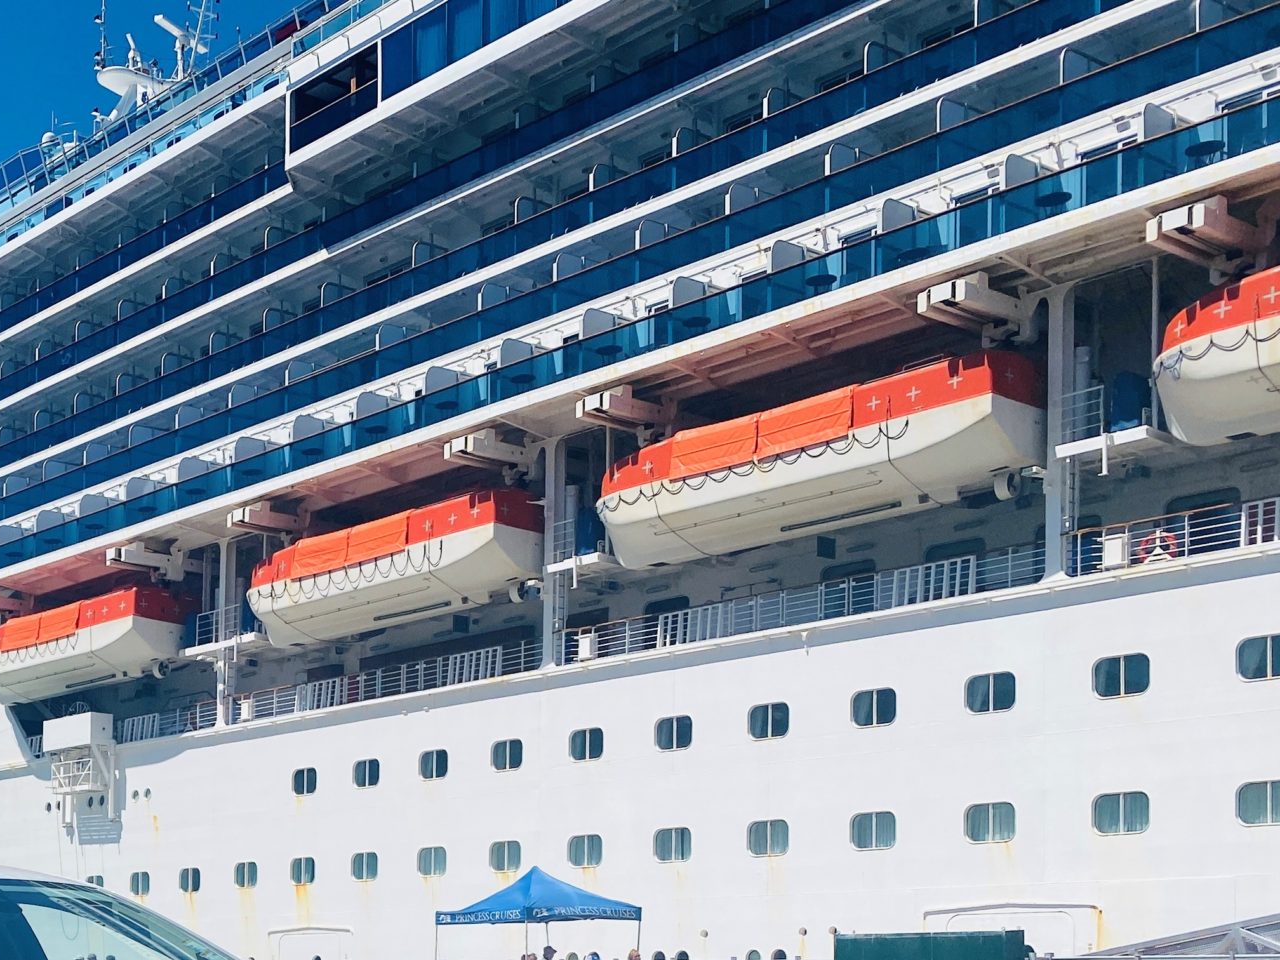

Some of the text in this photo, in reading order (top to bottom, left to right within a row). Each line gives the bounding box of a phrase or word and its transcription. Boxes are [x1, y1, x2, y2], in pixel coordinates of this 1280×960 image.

[455, 909, 521, 922] PRINCESS CRUISES
[554, 906, 636, 919] PRINCESS CRUISES
